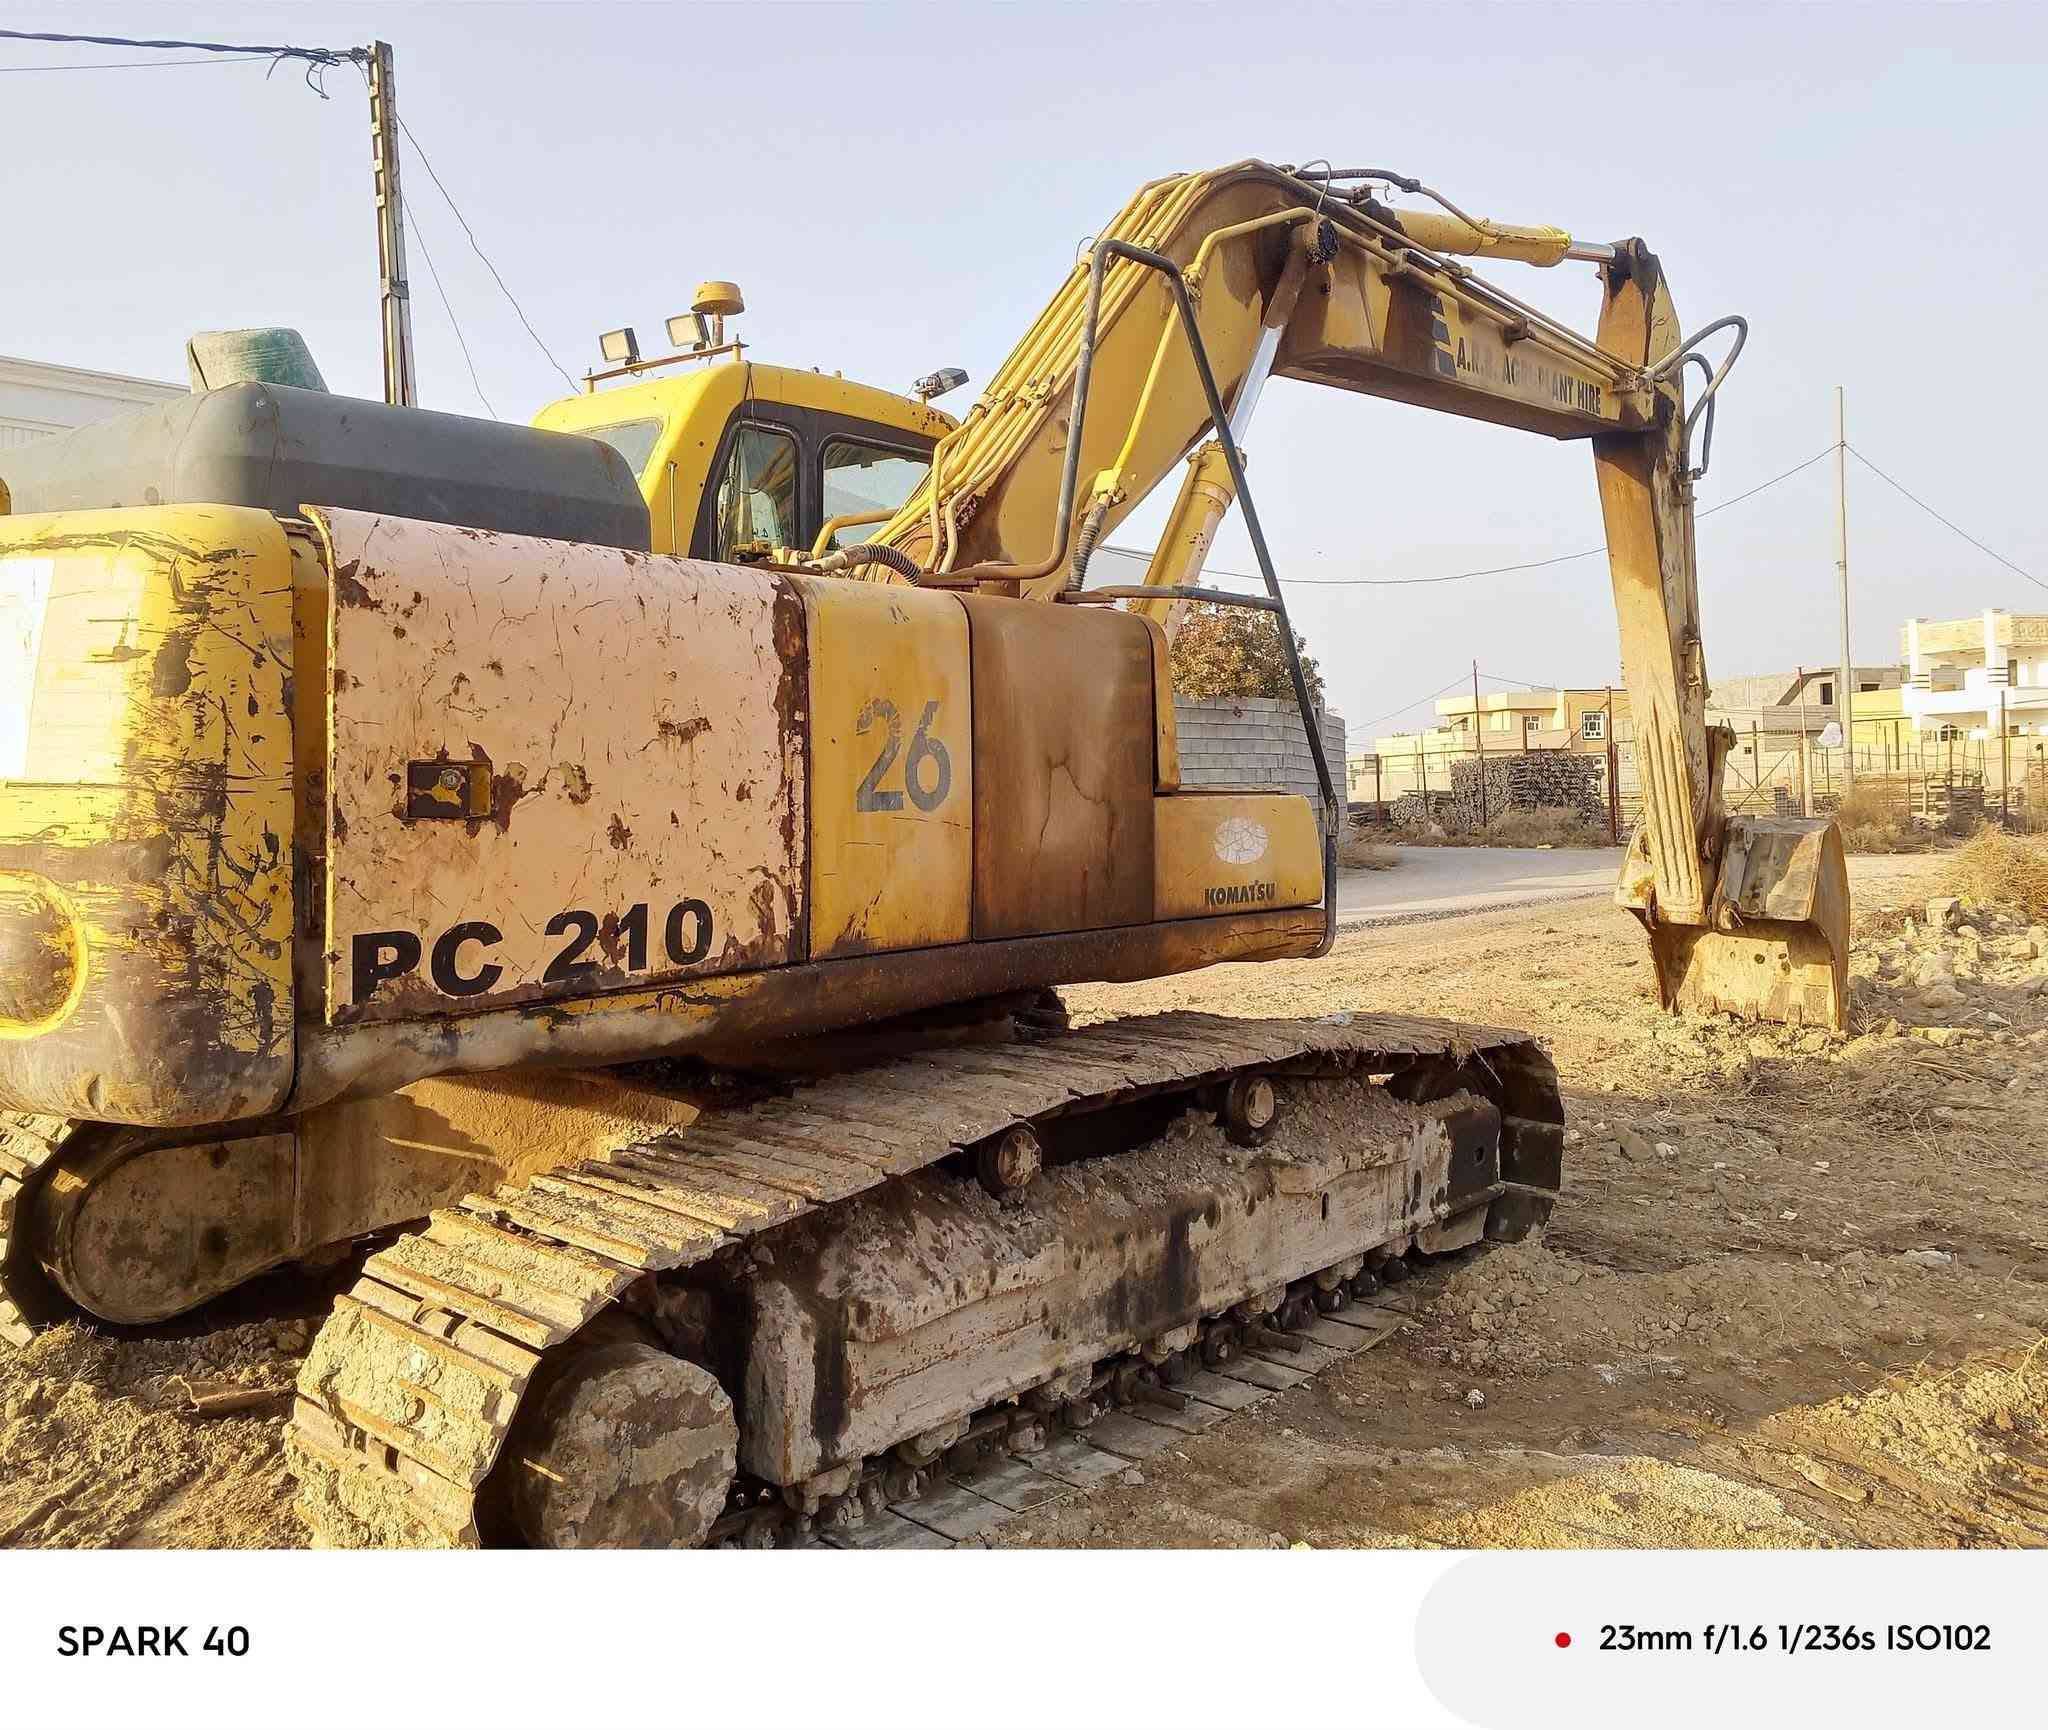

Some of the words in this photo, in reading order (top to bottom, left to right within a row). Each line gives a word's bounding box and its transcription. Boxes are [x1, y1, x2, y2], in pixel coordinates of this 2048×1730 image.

[1577, 378, 1600, 414] HIRE
[856, 698, 951, 812] 26
[1204, 880, 1276, 905] KOMATSU
[351, 920, 504, 1005] PC
[543, 898, 714, 983] 210
